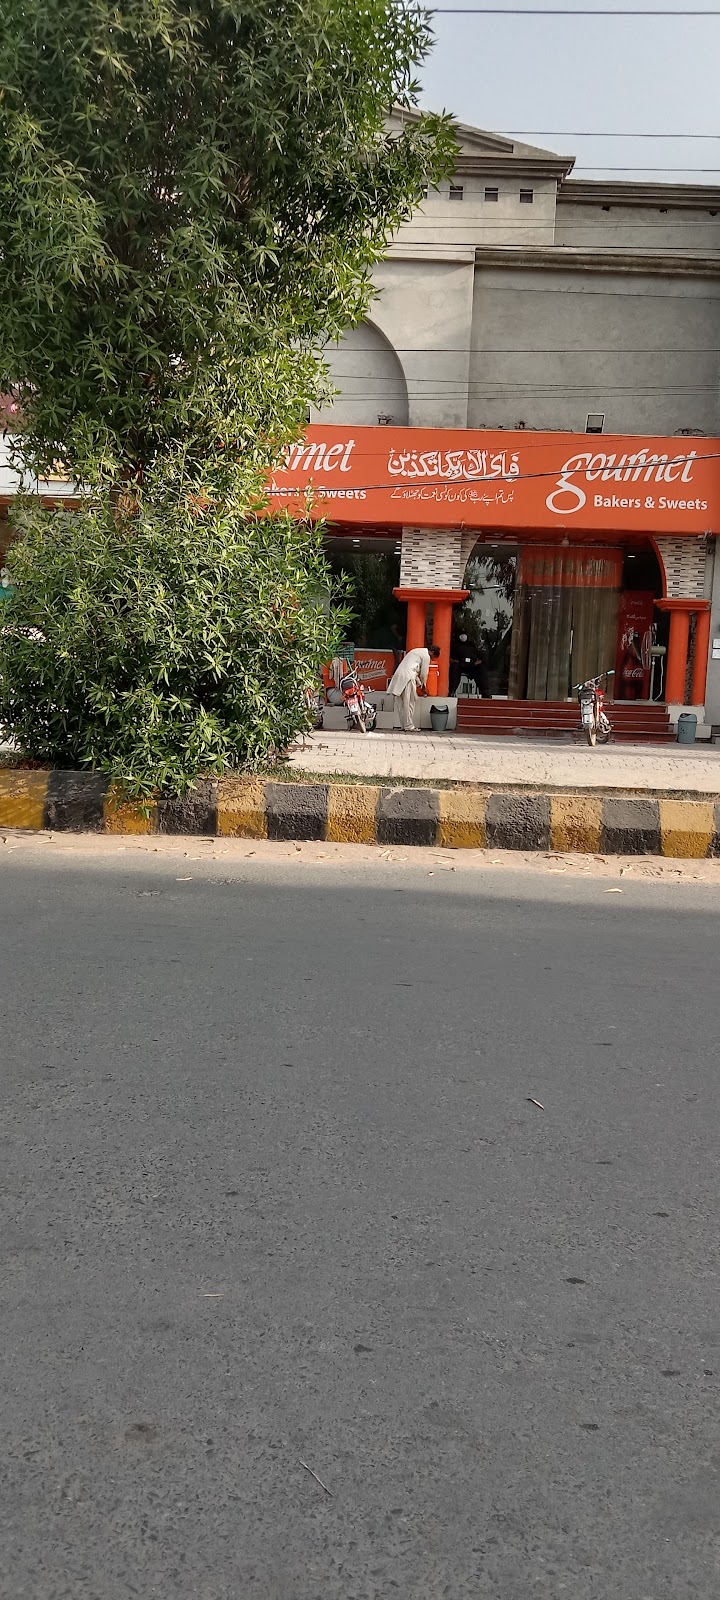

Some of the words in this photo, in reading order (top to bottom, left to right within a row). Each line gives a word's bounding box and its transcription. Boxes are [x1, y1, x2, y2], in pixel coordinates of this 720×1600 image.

[545, 448, 697, 514] gourmet
[260, 484, 300, 497] akers
[318, 486, 367, 499] Sweets
[594, 494, 641, 508] Bakers
[644, 496, 655, 509] &
[658, 496, 708, 511] Sweets
